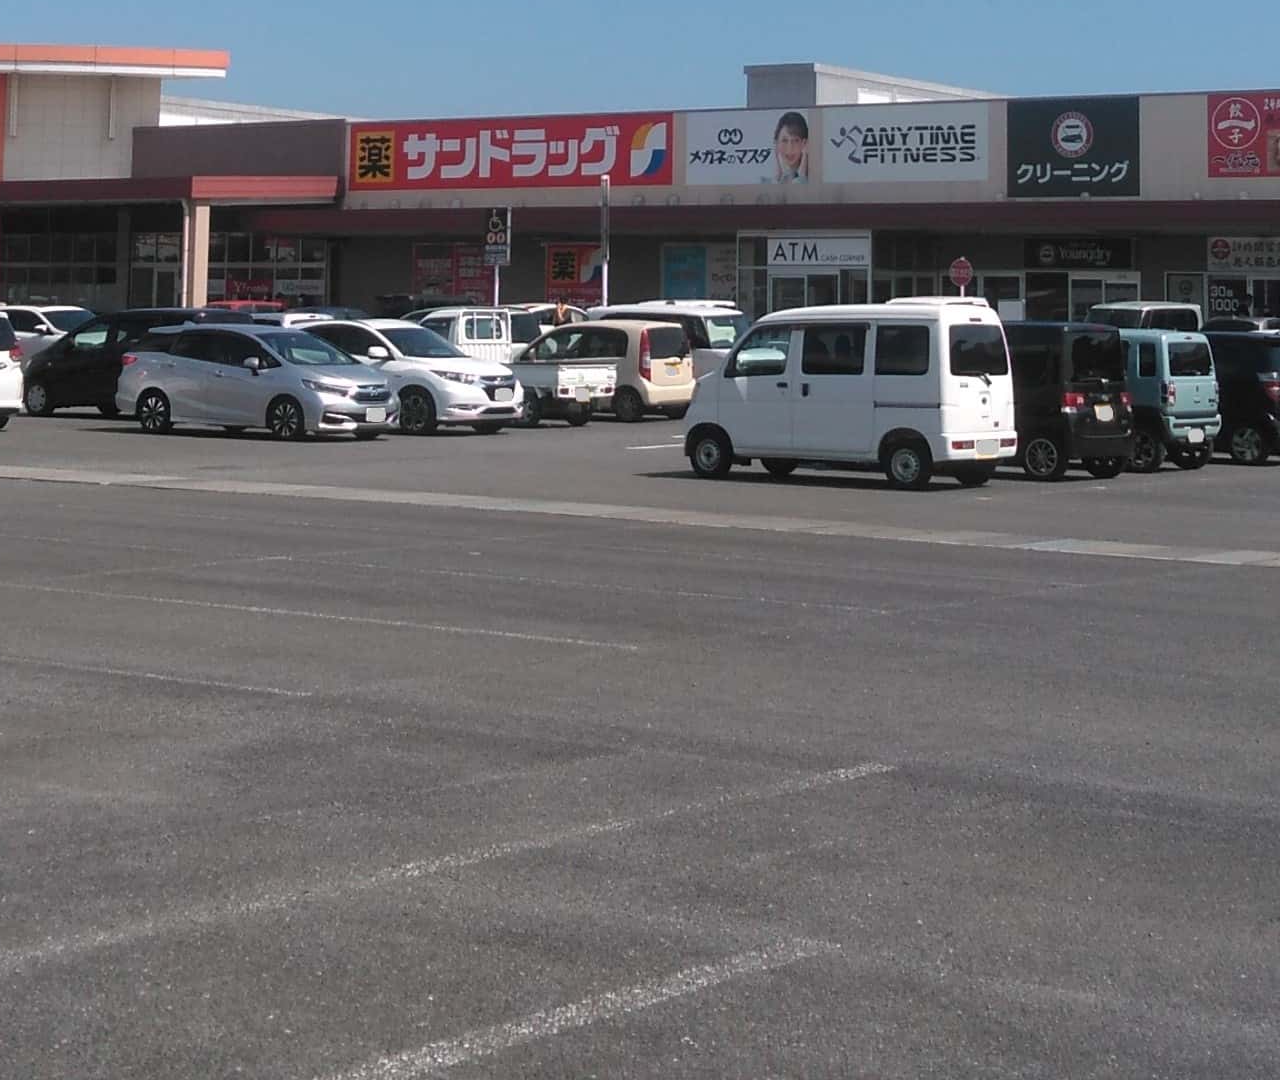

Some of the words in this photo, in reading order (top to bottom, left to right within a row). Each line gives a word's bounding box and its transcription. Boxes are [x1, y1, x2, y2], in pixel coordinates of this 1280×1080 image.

[861, 124, 977, 147] ANYTIME
[358, 135, 392, 180] 薬
[403, 124, 620, 180] サンドラッグ
[861, 146, 977, 164] FITNESS
[1017, 160, 1130, 184] クリーニング
[773, 241, 819, 261] ATM
